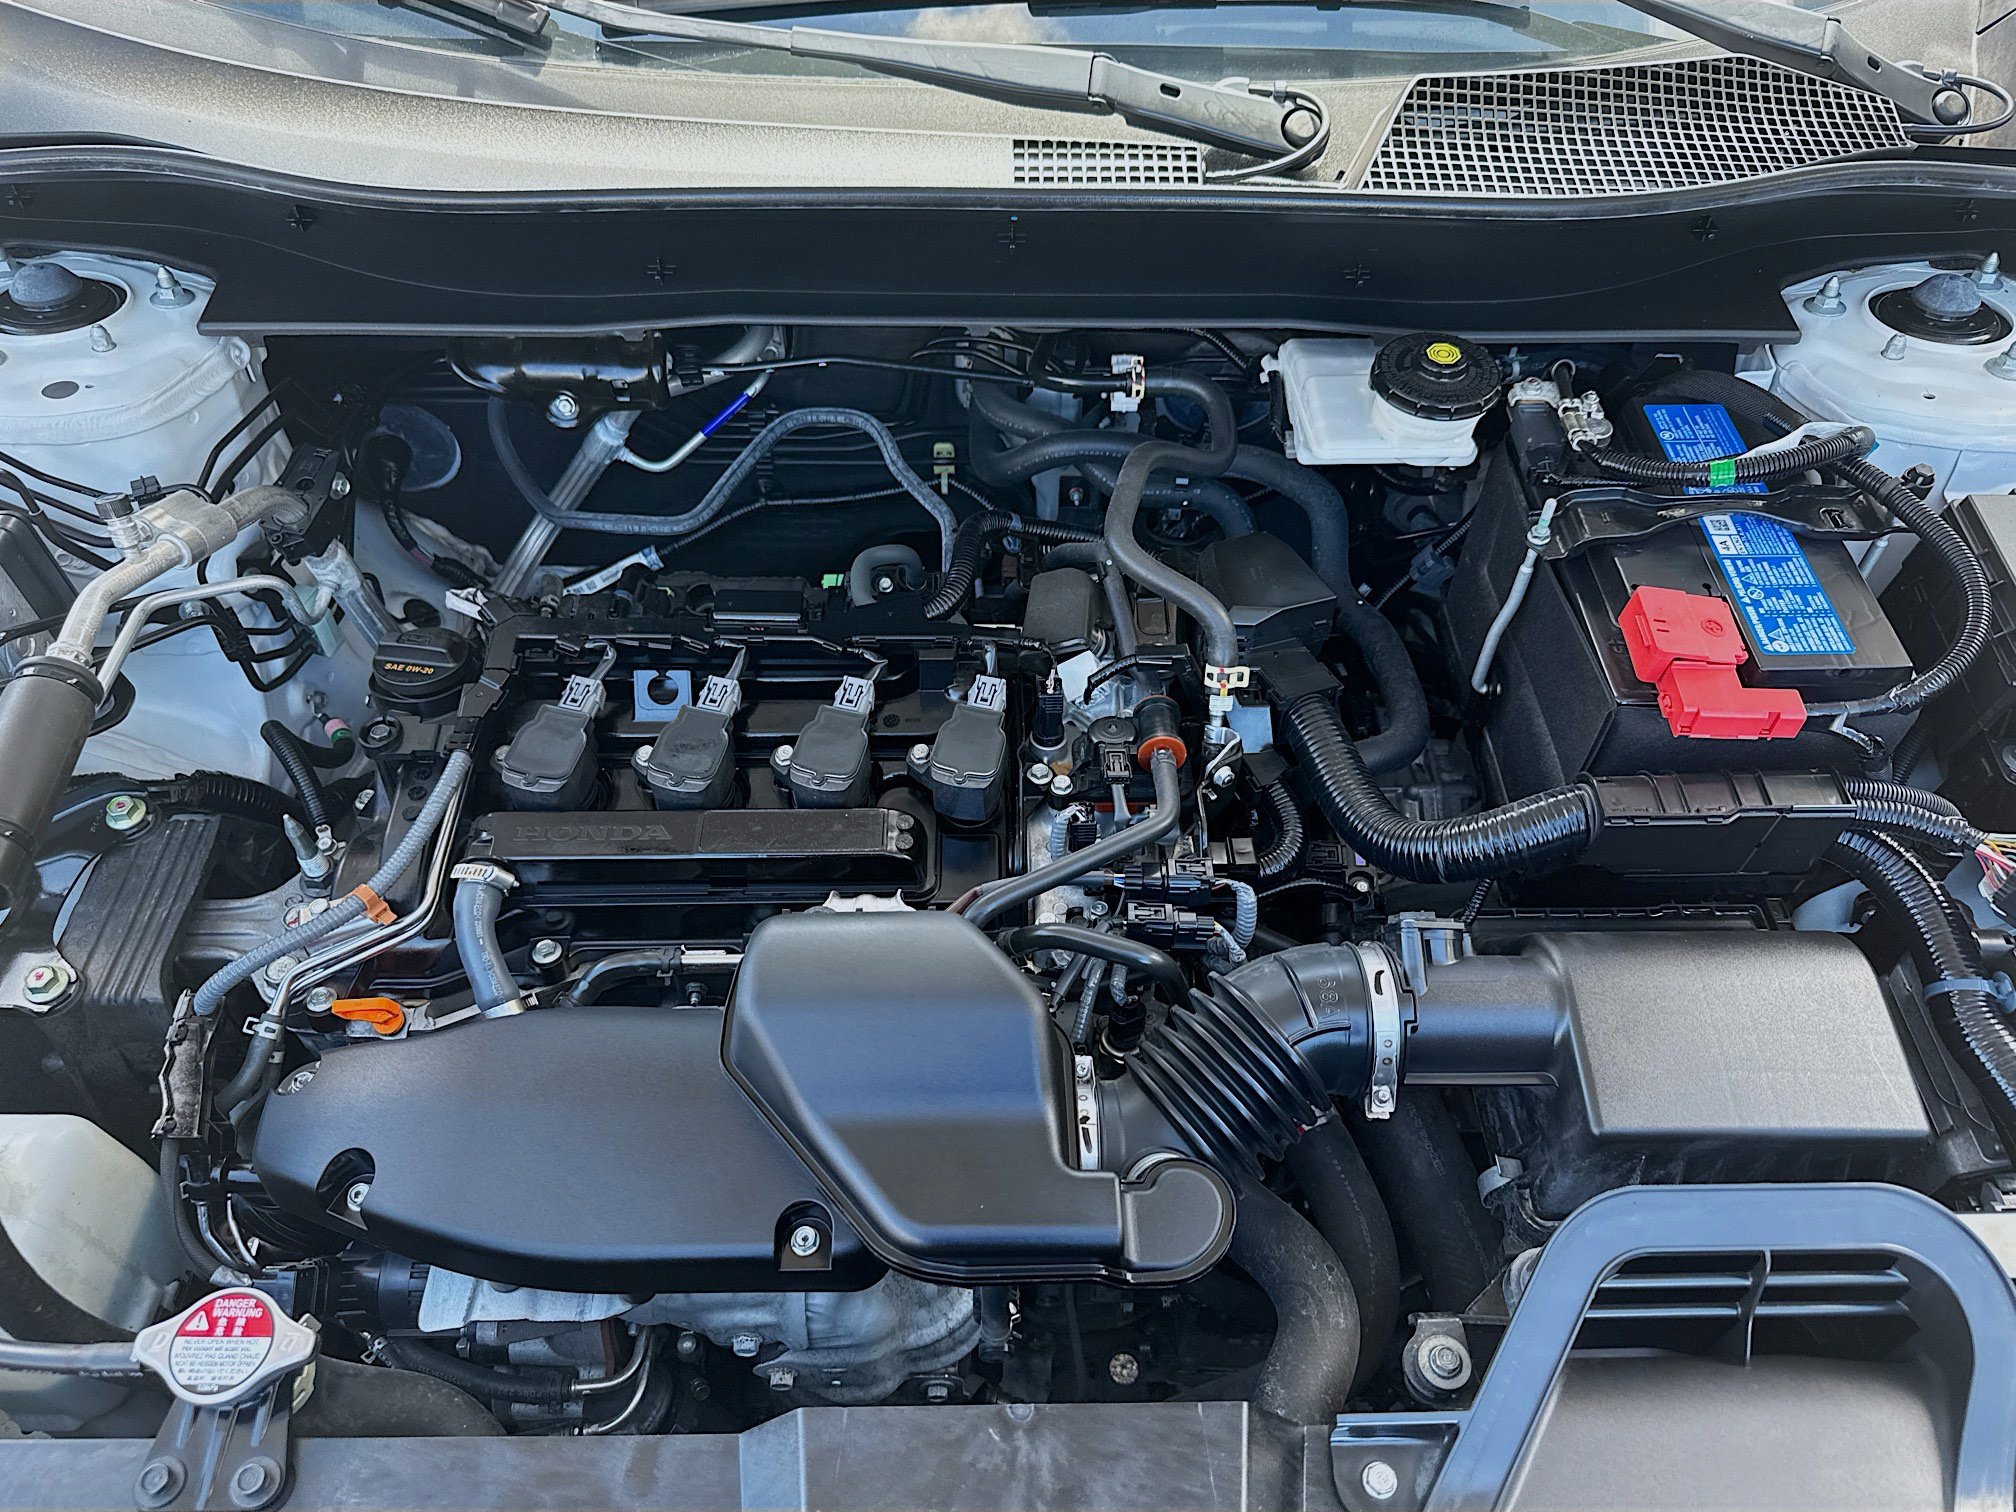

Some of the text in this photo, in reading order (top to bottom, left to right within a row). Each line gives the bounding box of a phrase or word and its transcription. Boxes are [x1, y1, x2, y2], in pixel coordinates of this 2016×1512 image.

[384, 662, 434, 675] SAE 0W-20
[513, 824, 673, 842] HONDA
[215, 1299, 257, 1308] DANGER
[213, 1307, 263, 1318] WARNUNG
